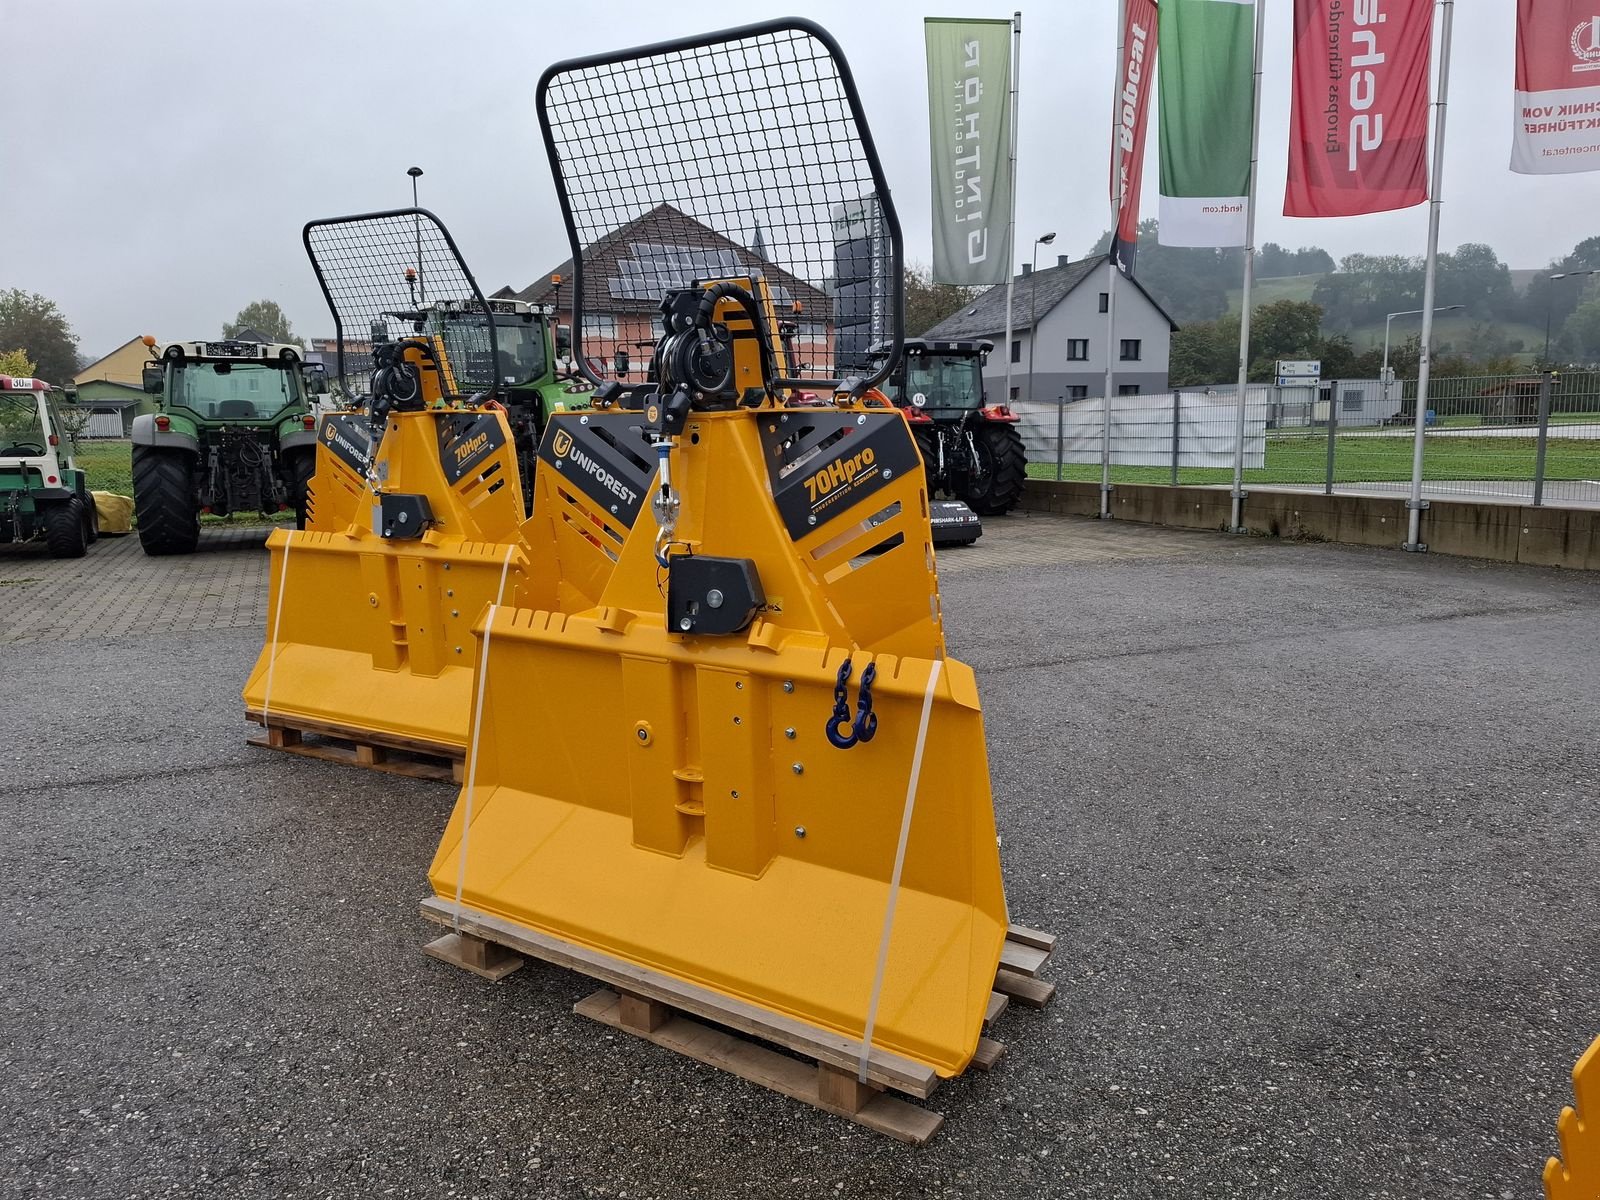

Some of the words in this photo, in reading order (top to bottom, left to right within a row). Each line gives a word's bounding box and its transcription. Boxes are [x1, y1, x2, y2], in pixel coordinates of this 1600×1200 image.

[1120, 22, 1147, 153] Bobcat
[13, 379, 24, 388] 30
[915, 395, 924, 405] 40
[454, 432, 487, 463] 70Hpro
[569, 446, 637, 505] UNIFOREST
[803, 447, 875, 503] 70Hpro
